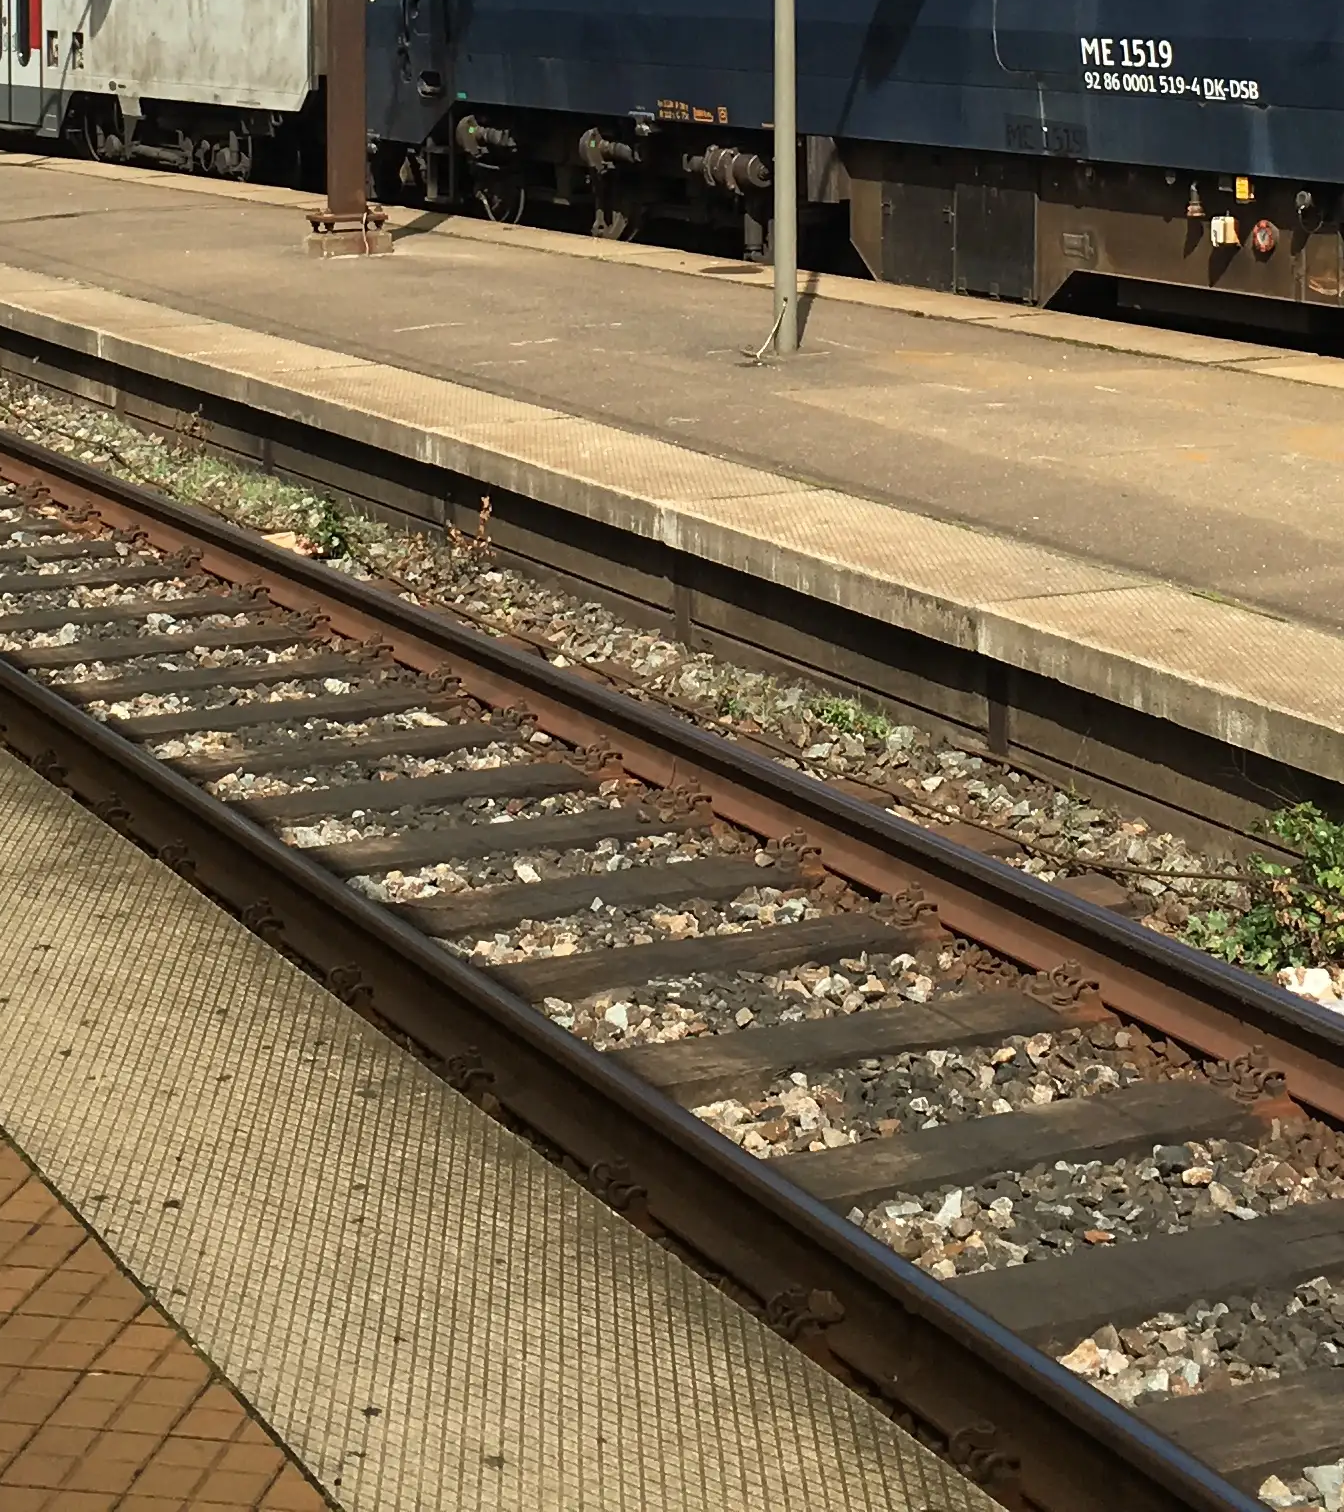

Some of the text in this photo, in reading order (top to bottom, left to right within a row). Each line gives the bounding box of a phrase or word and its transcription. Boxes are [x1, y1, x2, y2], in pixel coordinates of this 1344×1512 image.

[1080, 37, 1174, 69] ME 1519
[1084, 71, 1260, 100] 92 86 0001 519-4 DK-DSB
